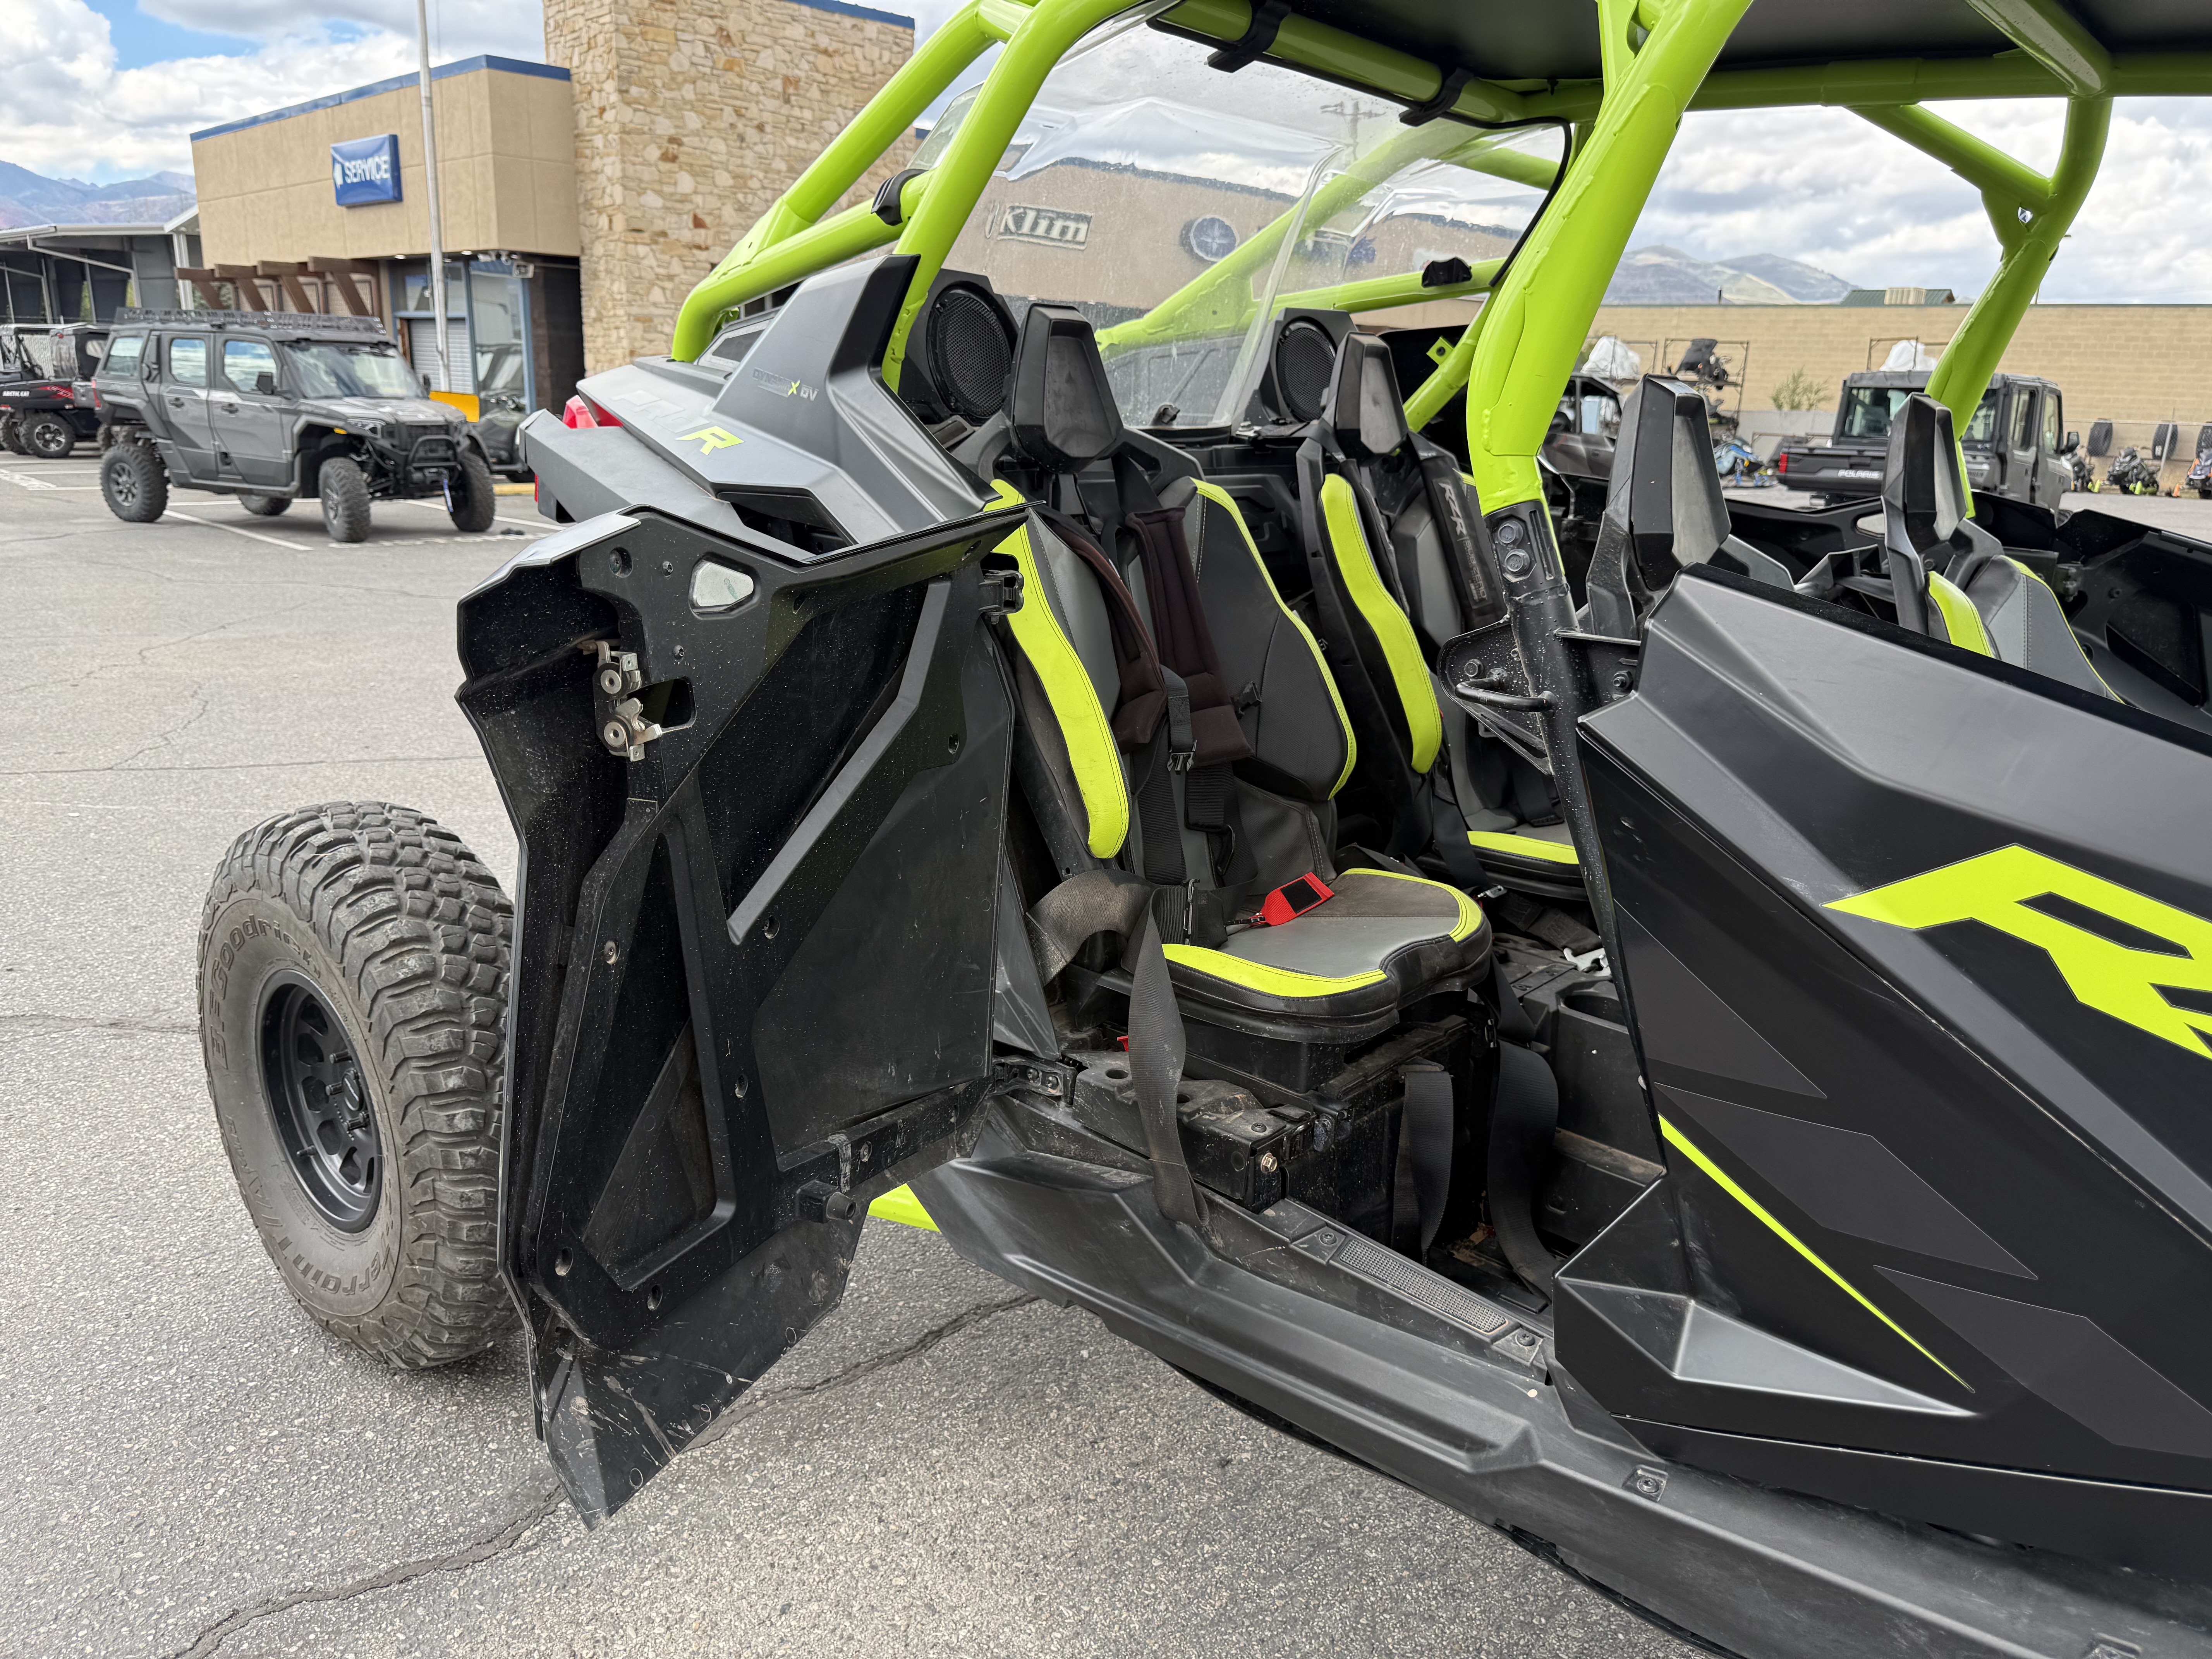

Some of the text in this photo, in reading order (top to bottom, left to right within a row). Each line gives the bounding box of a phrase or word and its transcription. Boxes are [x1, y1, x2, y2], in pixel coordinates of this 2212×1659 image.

[344, 155, 390, 184] SERVICE
[800, 384, 819, 402] DV
[1838, 469, 1881, 479] POLARIS
[1438, 483, 1467, 536] RZR
[1465, 540, 1476, 565] SUB
[1472, 566, 1487, 599] ZERO
